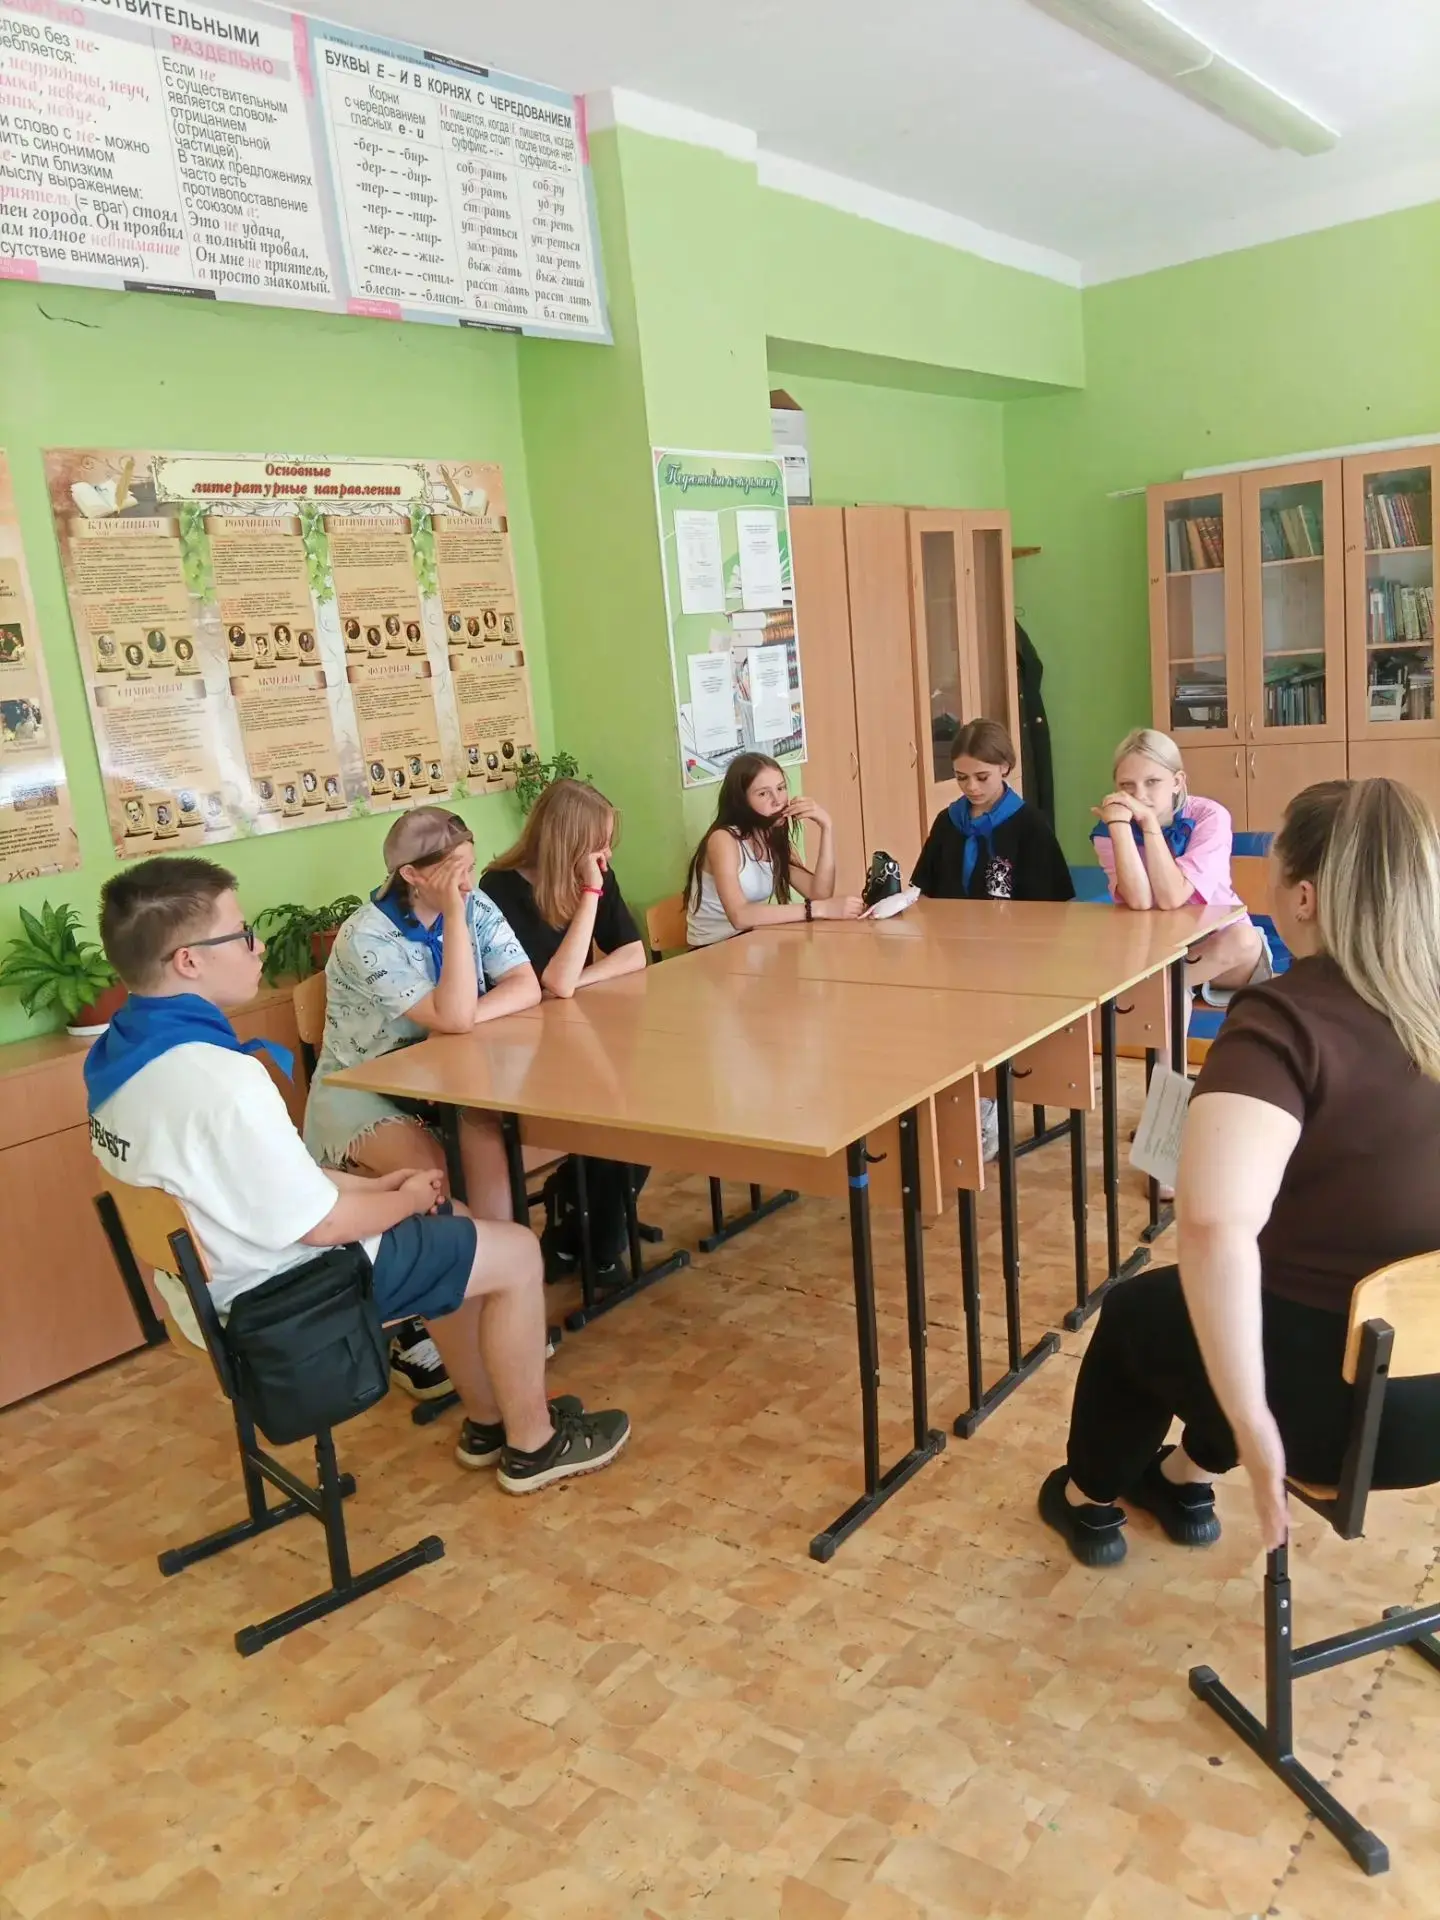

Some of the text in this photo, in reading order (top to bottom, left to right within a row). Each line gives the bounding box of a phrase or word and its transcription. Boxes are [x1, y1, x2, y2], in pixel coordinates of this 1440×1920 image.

[0, 18, 40, 39] лово
[44, 26, 71, 47] без
[0, 34, 77, 64] ебляется:
[171, 34, 274, 75] РАЗДЕЛЬНО
[162, 56, 217, 82] Если не
[165, 76, 288, 114] с существительным
[325, 49, 370, 75] БУКВЫ
[377, 63, 385, 79] Е
[400, 69, 408, 85] И
[413, 73, 422, 88] В
[428, 77, 472, 103] КОРНЯХ
[477, 91, 485, 106] С
[490, 95, 571, 129] ЧЕРЕДОВАНИЕМ
[368, 84, 400, 105] Корни
[168, 91, 278, 124] является словом-
[170, 106, 247, 132] отрицанием
[344, 96, 426, 125] с чередованием
[14, 117, 59, 137] слово
[63, 127, 72, 140] с
[104, 135, 150, 154] можно
[173, 118, 271, 151] (отрицательной
[350, 112, 393, 132] гласных
[440, 119, 511, 147] после корня стоит
[488, 119, 510, 133] когда
[0, 130, 116, 164] ить синонимом
[175, 136, 242, 161] частицей).
[452, 136, 488, 154] суффикс
[515, 139, 537, 153] после
[21, 152, 50, 169] или
[53, 155, 114, 179] близким
[178, 148, 312, 186] В таких предложениях
[180, 166, 247, 189] часто есть
[48, 173, 143, 200] выражением:
[182, 181, 308, 212] противопоставление
[93, 199, 128, 219] враг)
[132, 205, 178, 223] стоял
[185, 197, 193, 208] с
[196, 199, 243, 216] союзом
[32, 207, 93, 228] города.
[96, 213, 120, 231] Он
[123, 221, 184, 240] проявил
[188, 210, 285, 242] Это не удача,
[28, 226, 86, 244] полное
[91, 232, 181, 256] невнимание
[193, 232, 309, 260] а полный провал.
[70, 249, 149, 272] внимания).
[195, 246, 329, 279] Он мне не приятель,
[198, 267, 331, 294] а просто знакомый.
[265, 463, 332, 477] Основные
[192, 481, 401, 498] литературные направления
